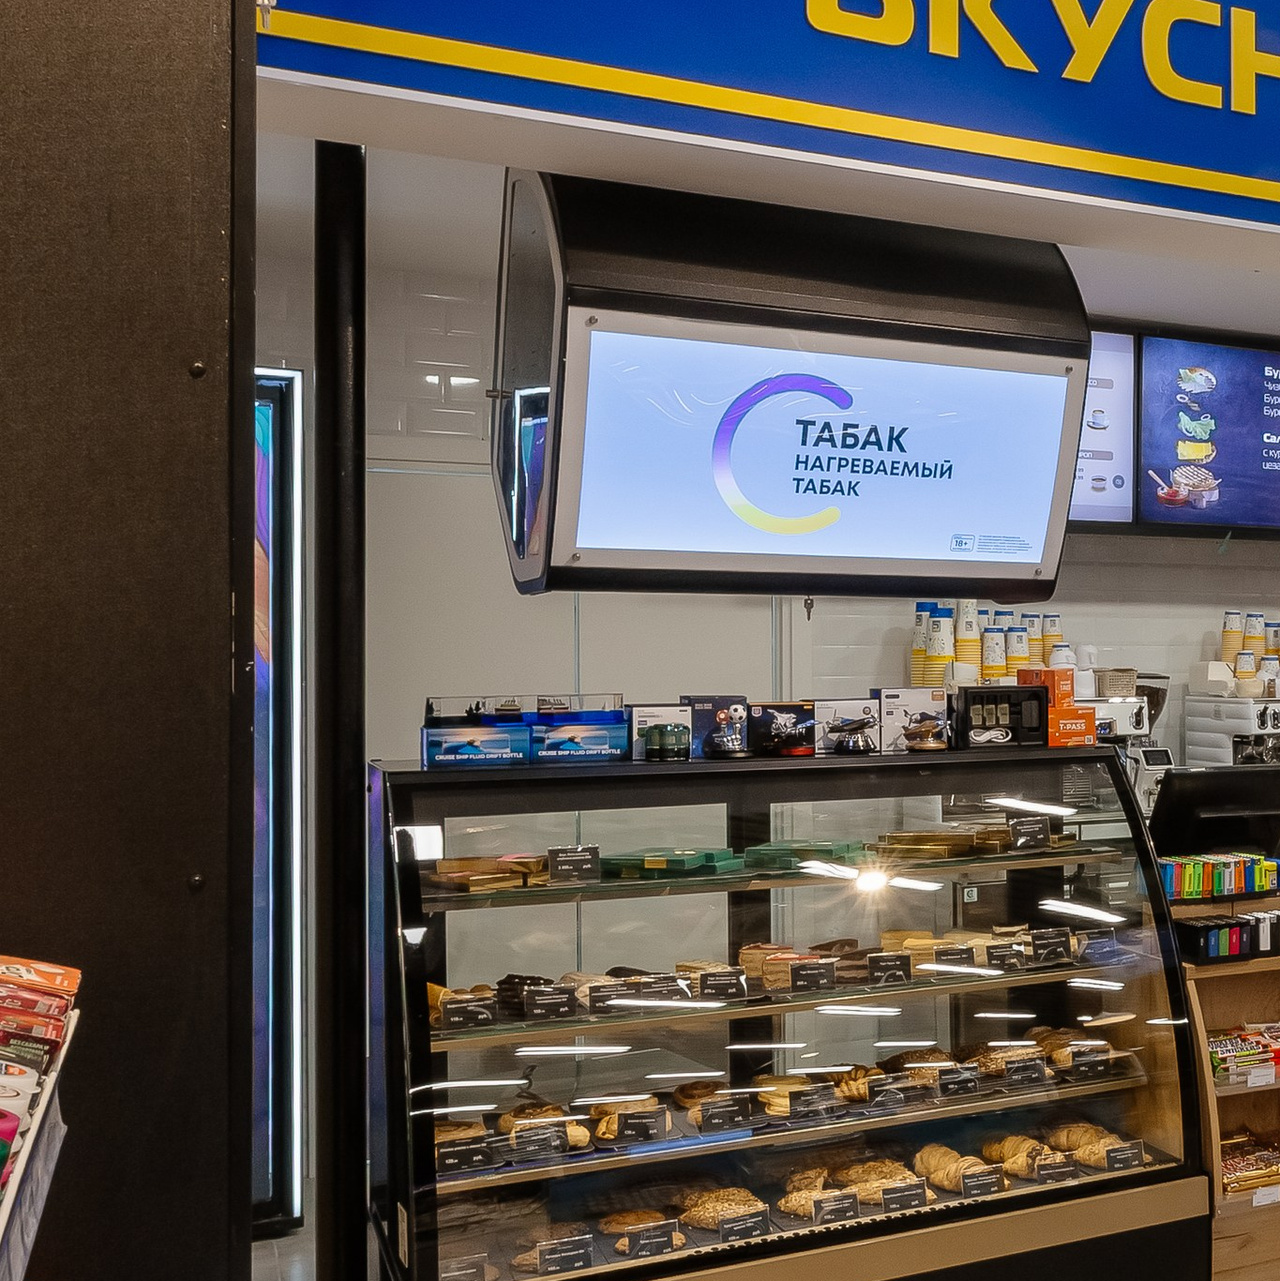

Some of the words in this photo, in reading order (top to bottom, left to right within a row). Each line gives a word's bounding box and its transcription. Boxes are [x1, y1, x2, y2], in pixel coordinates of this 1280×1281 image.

[795, 419, 909, 453] ТАБАК
[794, 454, 954, 479] НАГРЕВАЕМЫЙ
[792, 477, 861, 497] ТАБАК
[434, 753, 455, 761] CRUISE
